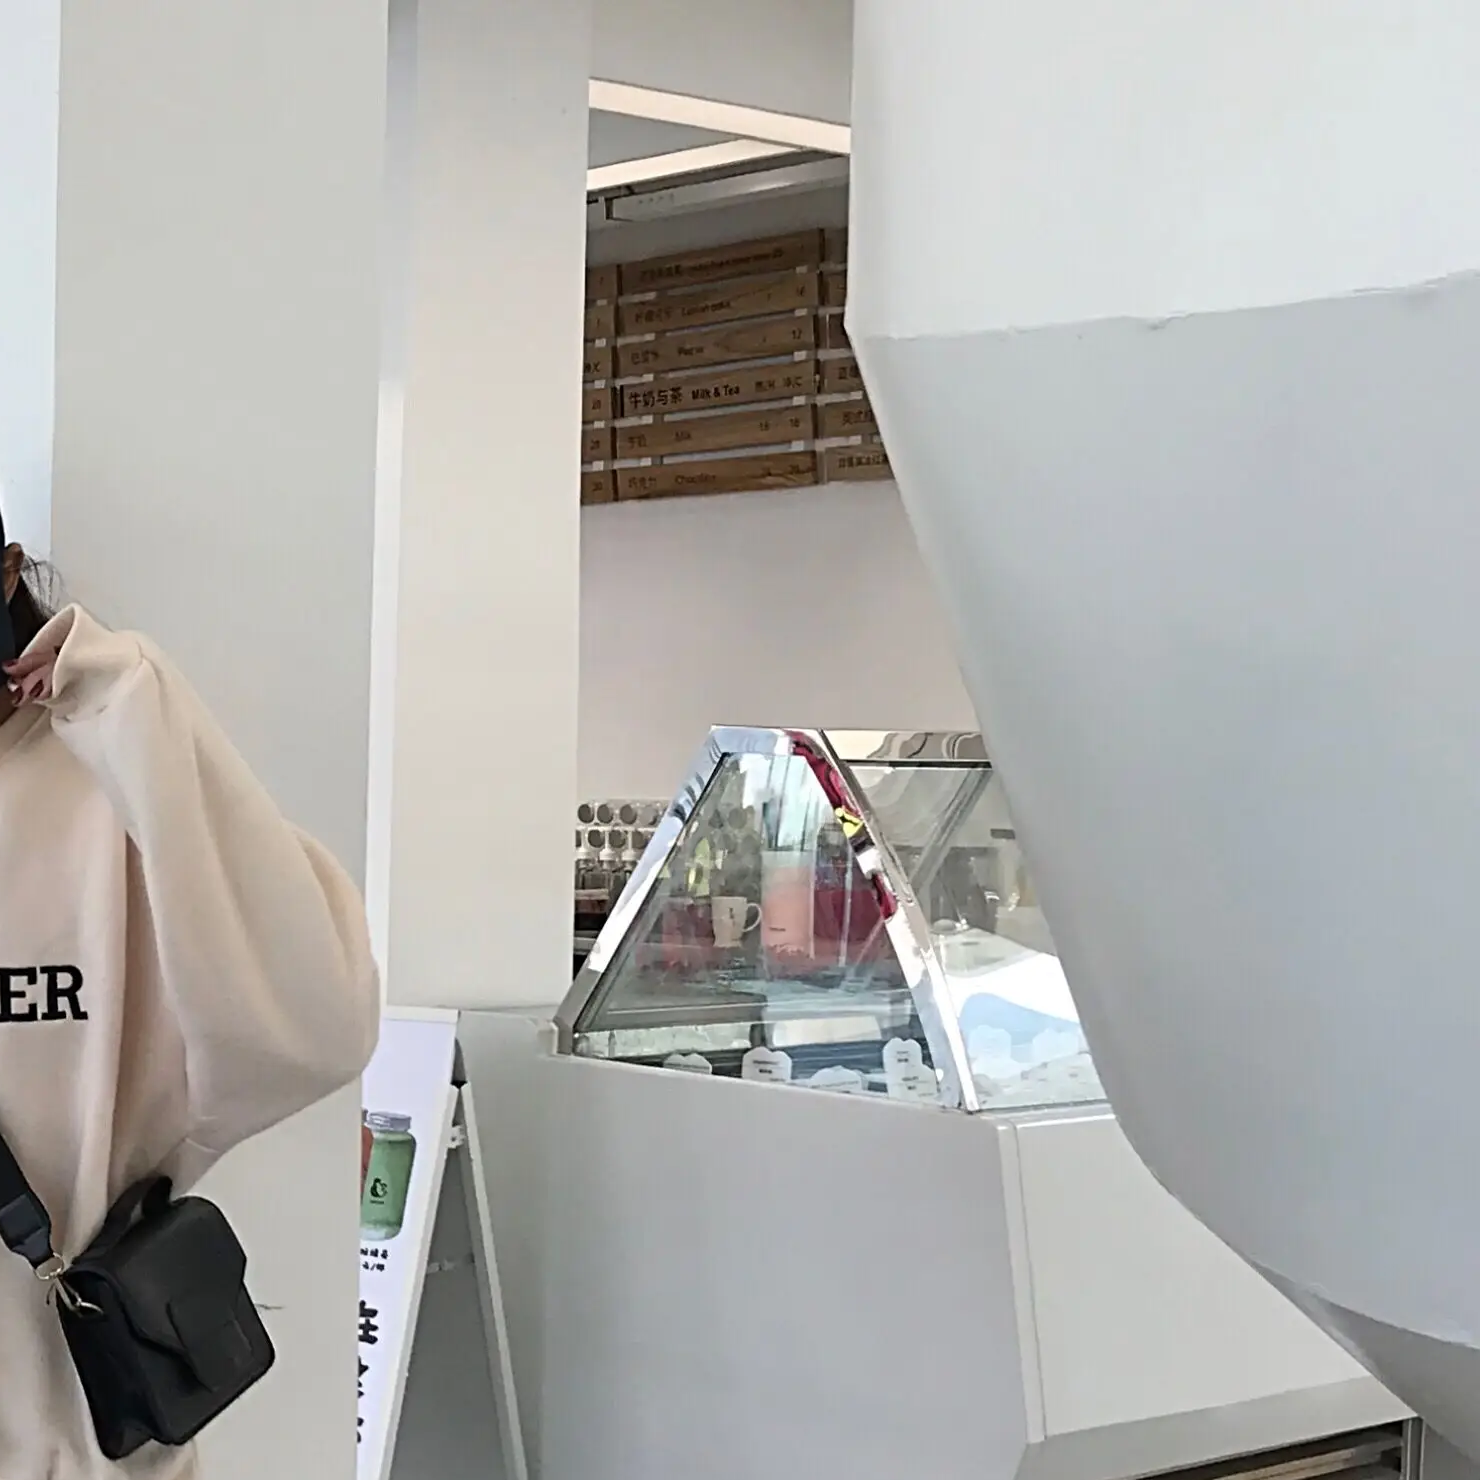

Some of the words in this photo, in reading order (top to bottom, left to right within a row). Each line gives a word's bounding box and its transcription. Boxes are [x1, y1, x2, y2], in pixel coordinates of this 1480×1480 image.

[628, 386, 684, 409] 牛奶与茶
[691, 390, 712, 400] Milk
[723, 384, 740, 396] Tea
